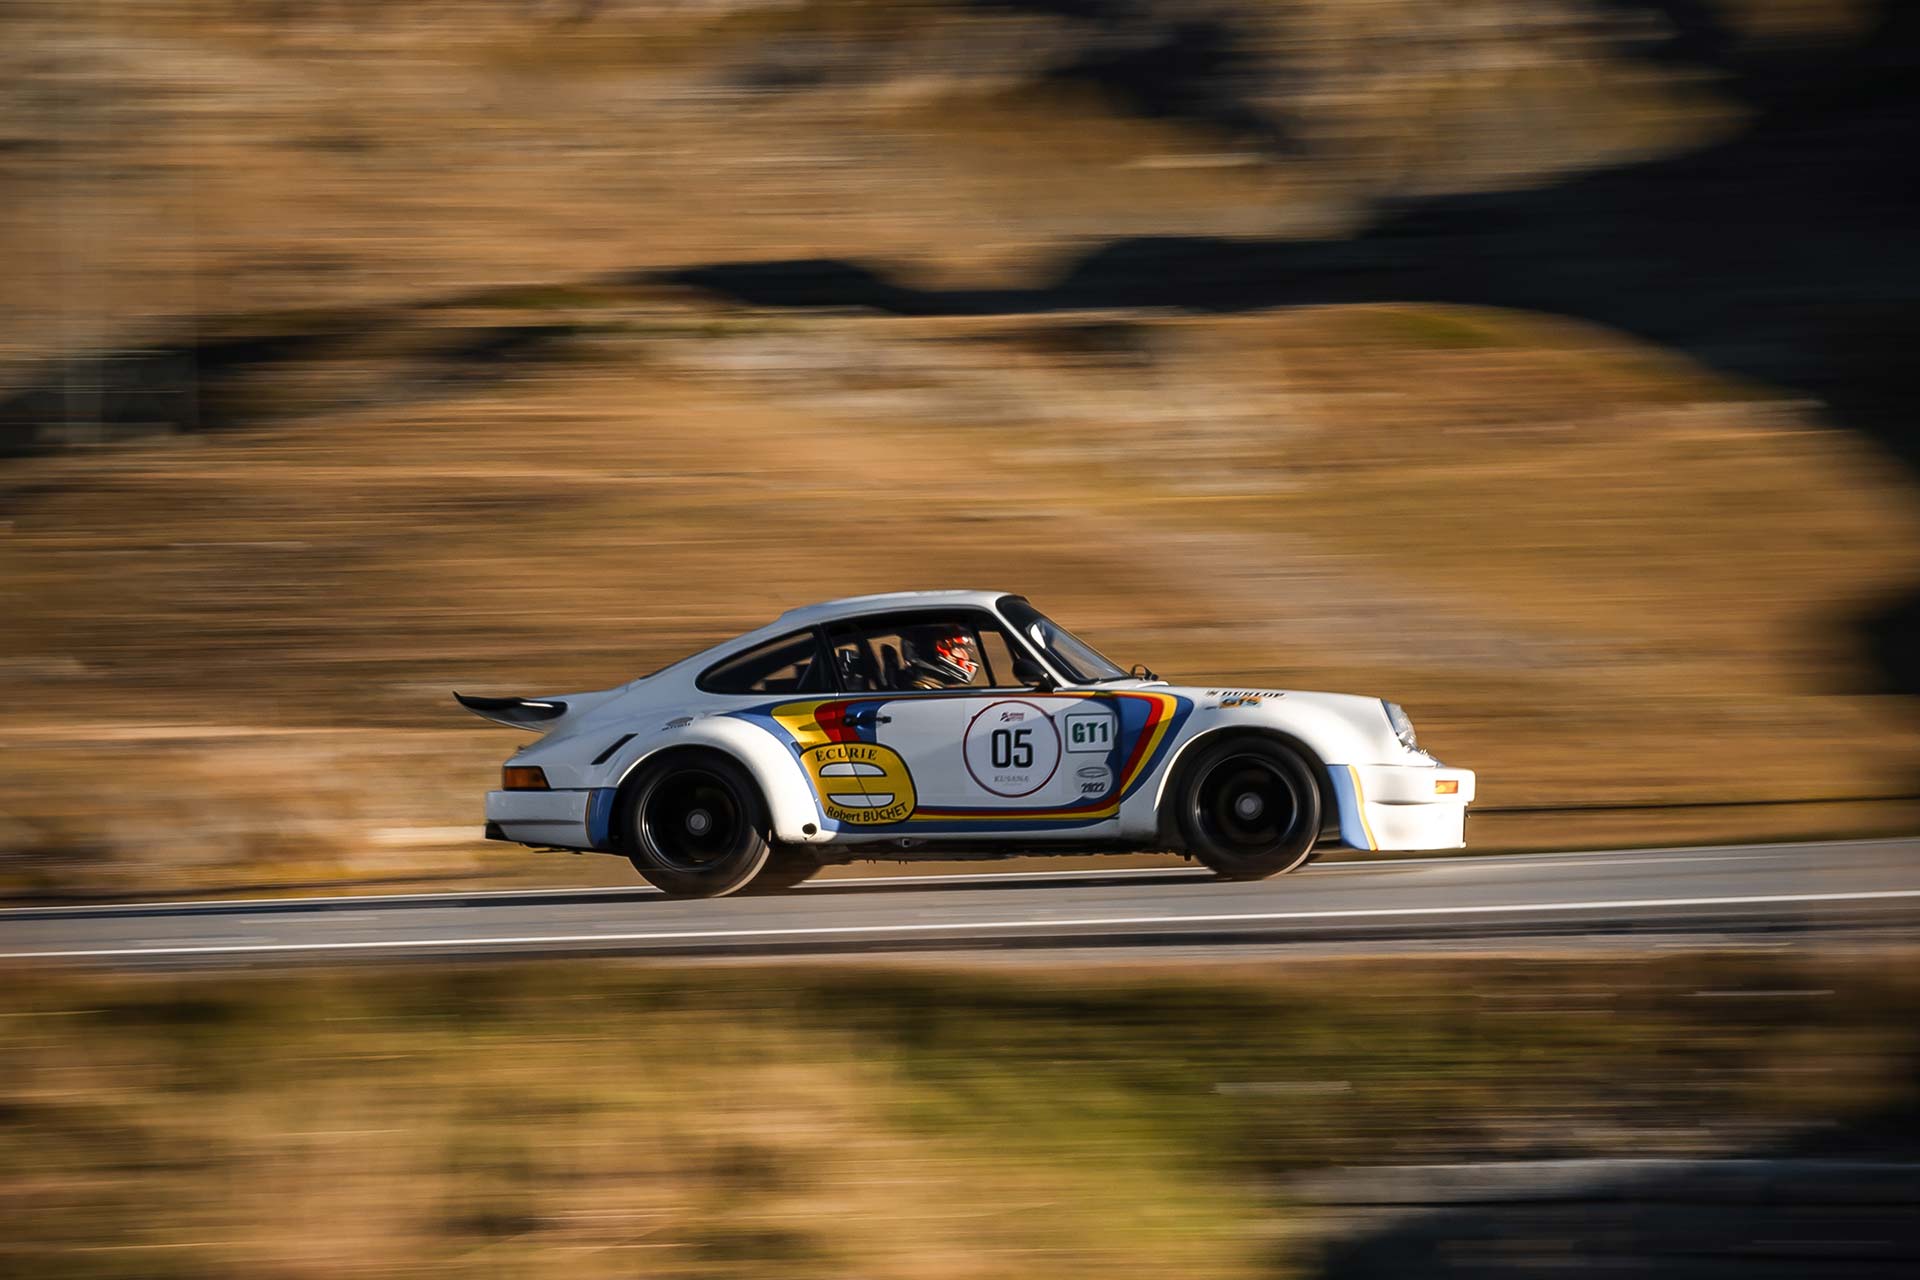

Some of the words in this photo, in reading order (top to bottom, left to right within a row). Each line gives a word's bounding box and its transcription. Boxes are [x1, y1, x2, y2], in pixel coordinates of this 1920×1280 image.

[1072, 722, 1108, 744] GT1
[991, 728, 1034, 768] 05
[827, 806, 860, 822] Robert
[863, 802, 907, 822] BUCHET
